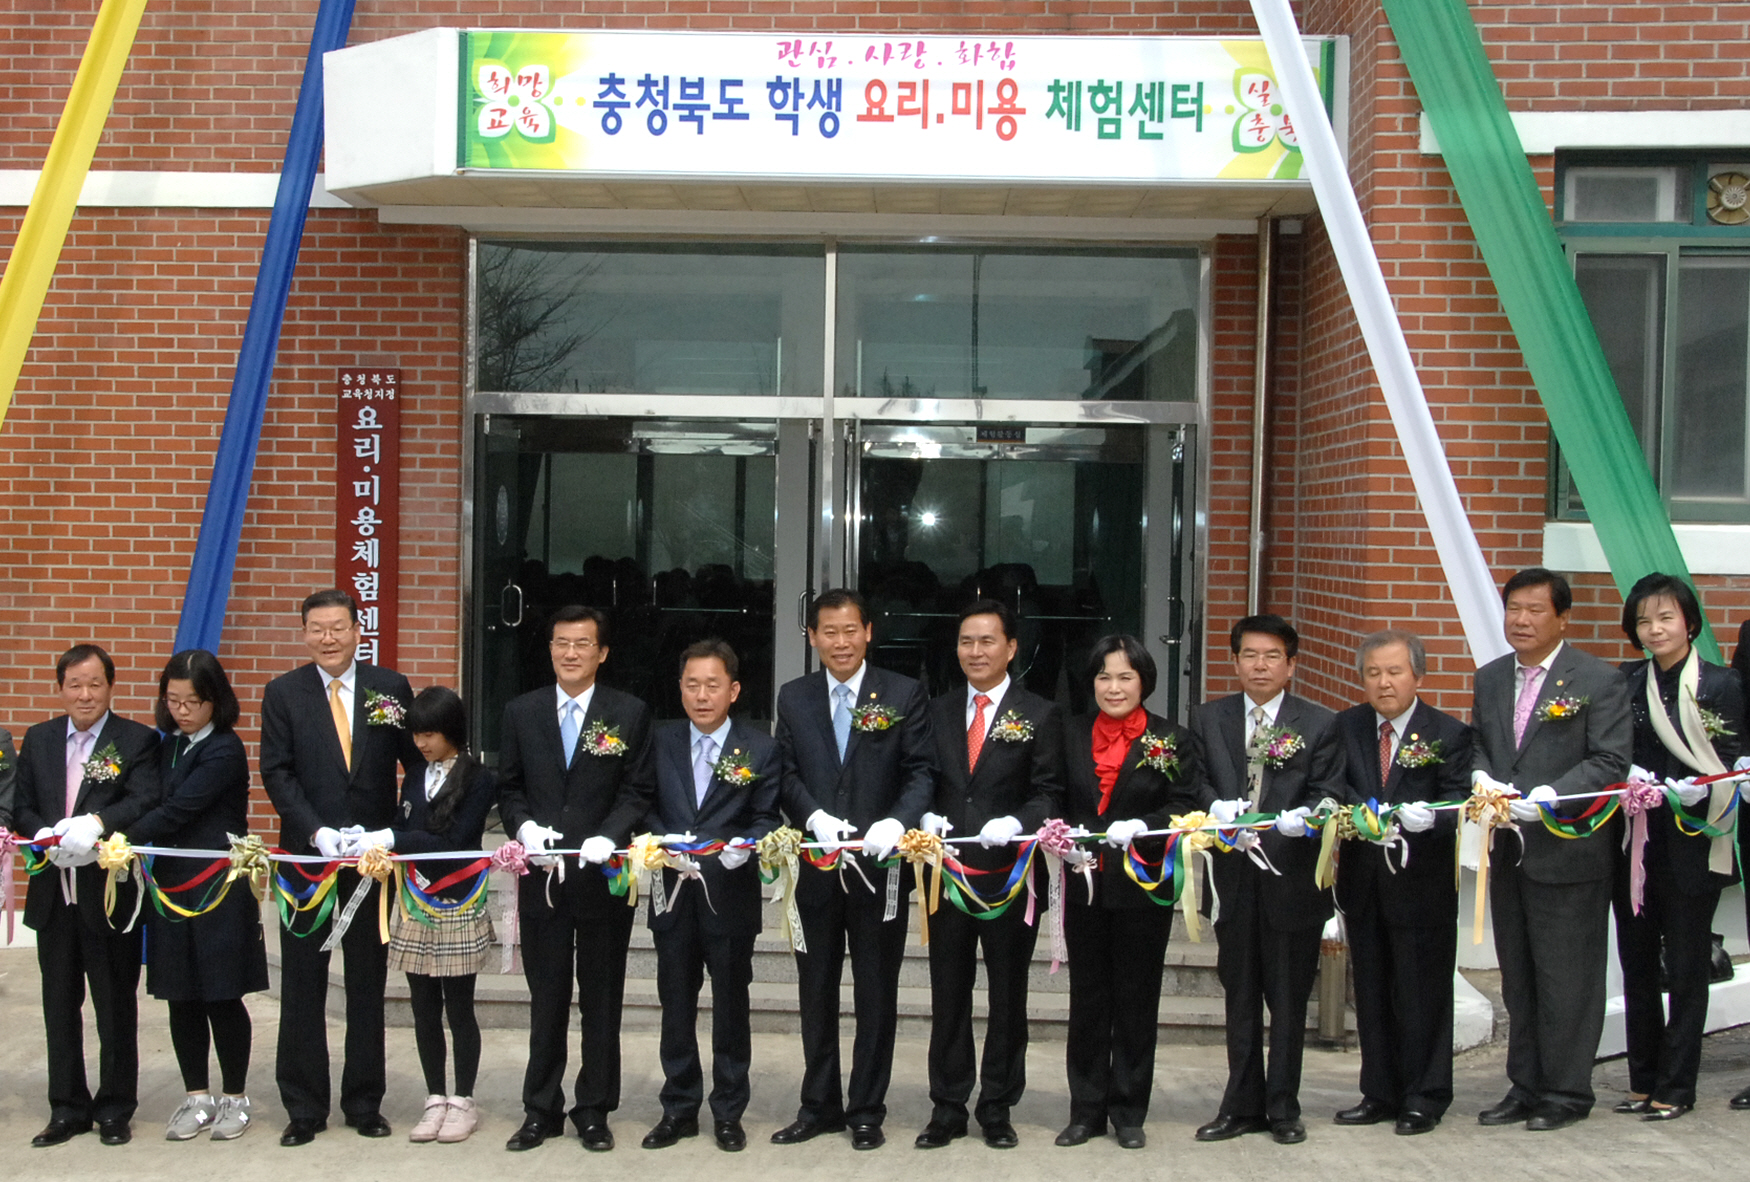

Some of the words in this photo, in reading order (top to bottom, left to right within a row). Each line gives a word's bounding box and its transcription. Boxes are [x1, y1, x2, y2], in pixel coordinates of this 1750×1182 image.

[487, 71, 543, 98] 희망
[487, 106, 540, 133] 교육
[593, 72, 750, 136] 충청북도
[766, 75, 842, 138] 학생
[1045, 79, 1203, 140] 체험센터
[341, 373, 396, 386] 충청북도
